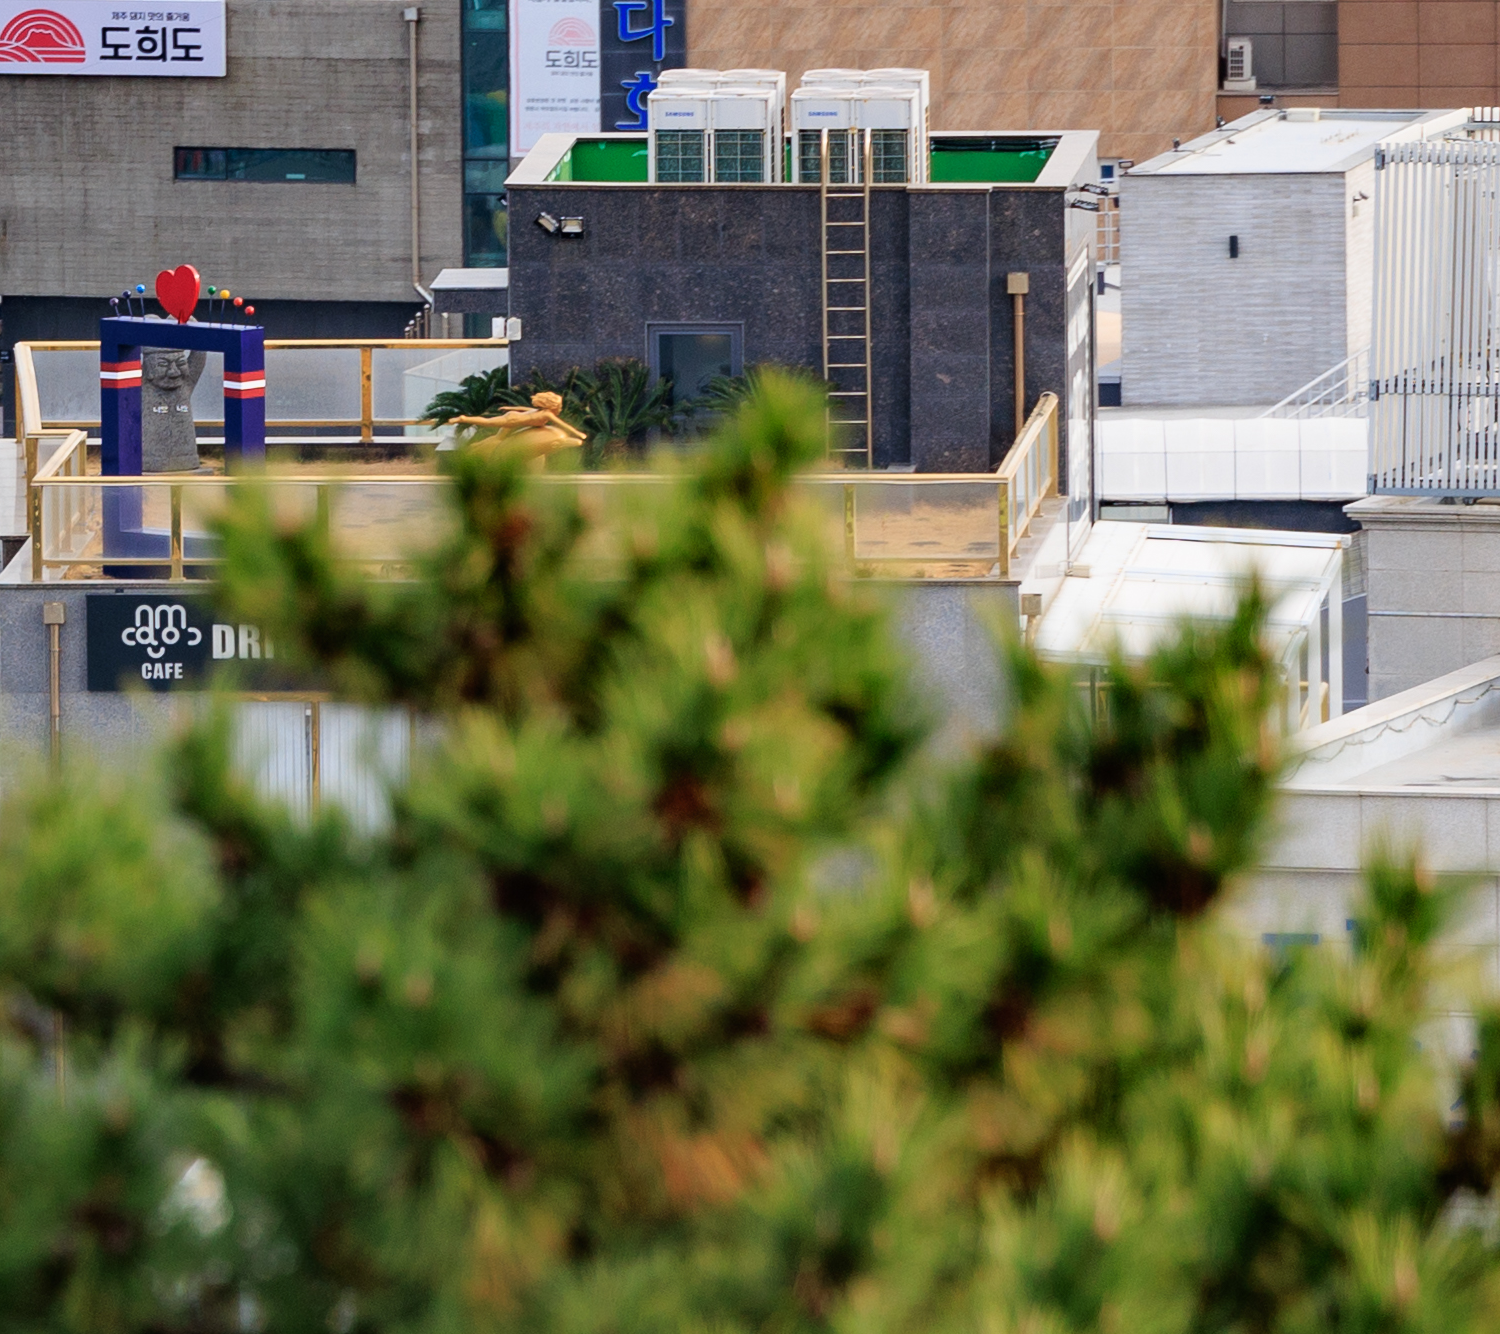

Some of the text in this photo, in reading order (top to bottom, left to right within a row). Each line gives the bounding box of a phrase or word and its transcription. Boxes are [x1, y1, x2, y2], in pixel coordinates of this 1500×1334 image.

[111, 12, 128, 21] 제주
[147, 12, 164, 21] 맛의
[166, 12, 190, 21] 즐거움
[99, 25, 204, 63] 도희도
[545, 50, 599, 69] 도희도
[141, 662, 184, 680] CAFE
